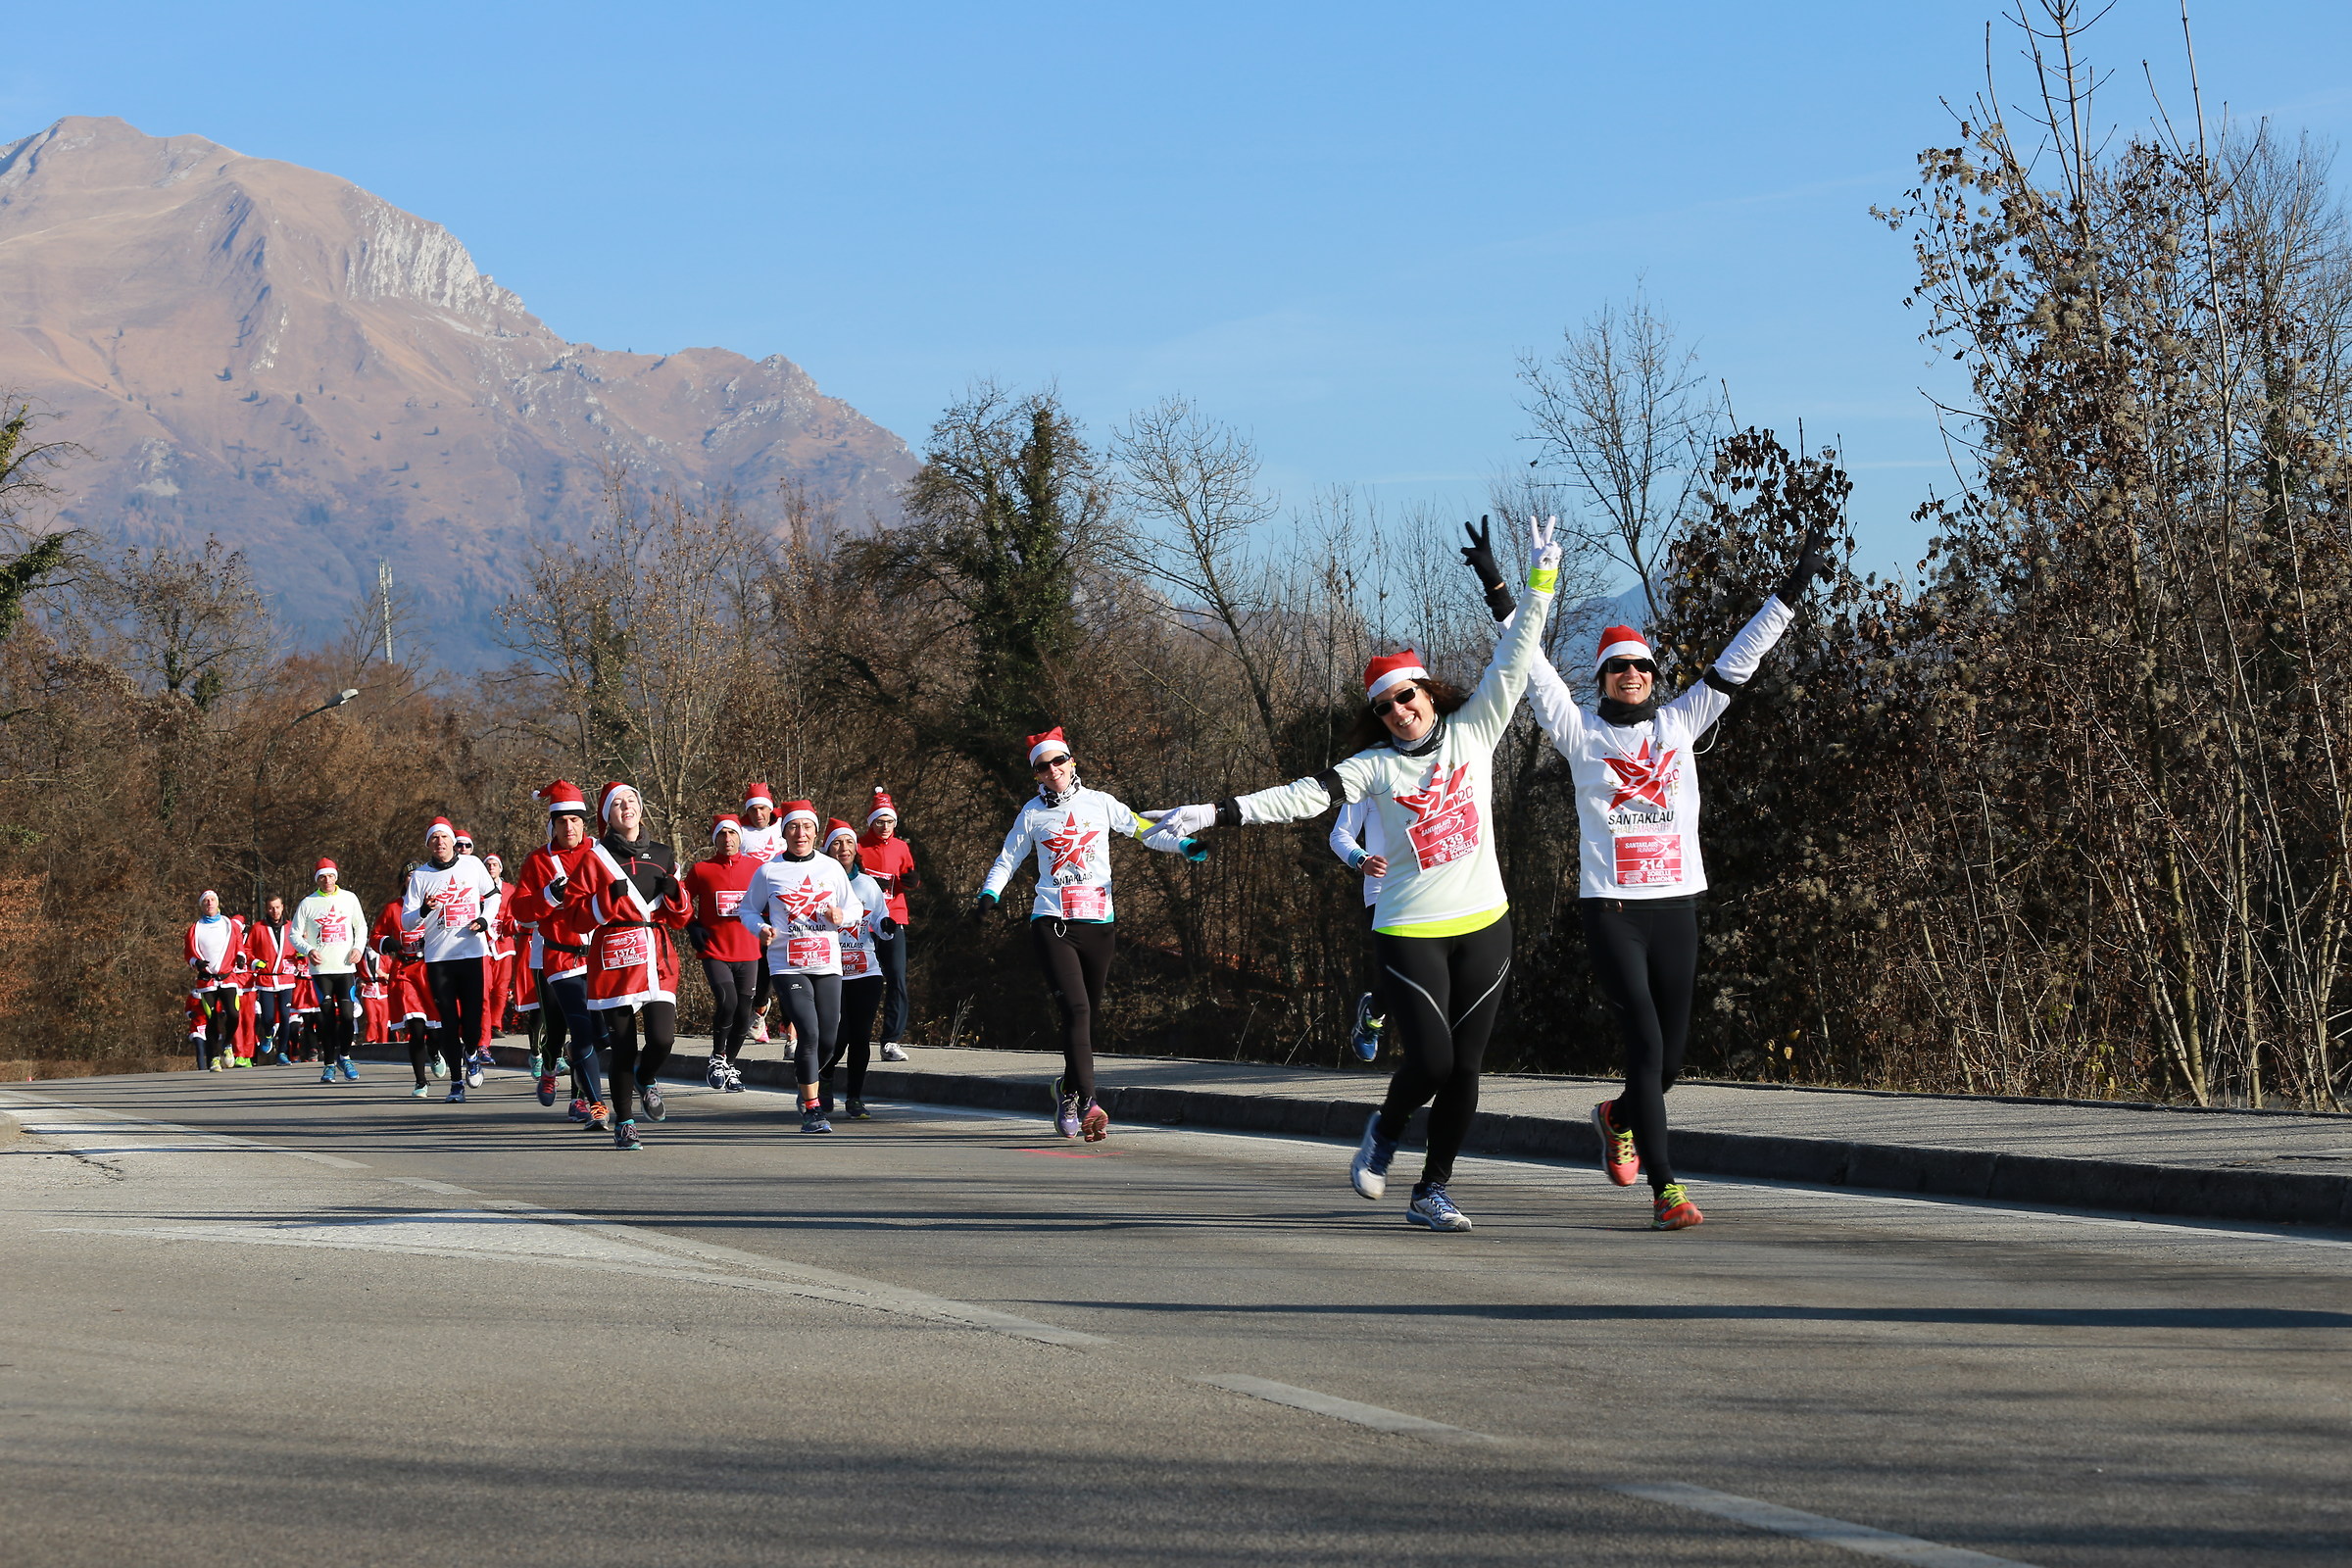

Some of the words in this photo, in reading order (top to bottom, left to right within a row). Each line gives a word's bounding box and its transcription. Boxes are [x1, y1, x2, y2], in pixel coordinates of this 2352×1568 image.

[1608, 810, 1675, 825] SANTAKLAU
[1616, 822, 1673, 834] HALFMARATH
[1439, 833, 1465, 851] 339
[1639, 858, 1666, 871] 214
[613, 947, 636, 958] 1374
